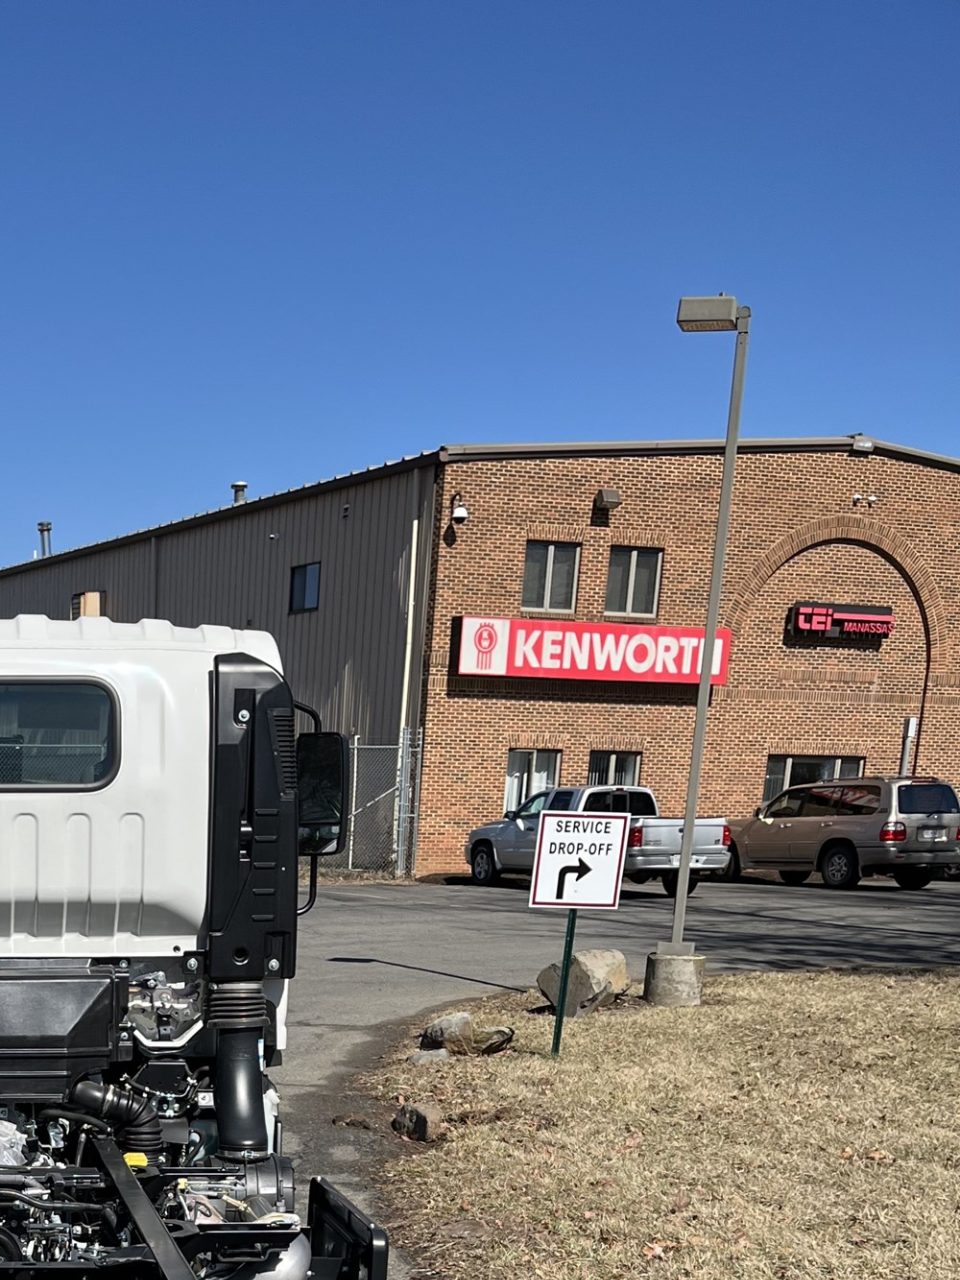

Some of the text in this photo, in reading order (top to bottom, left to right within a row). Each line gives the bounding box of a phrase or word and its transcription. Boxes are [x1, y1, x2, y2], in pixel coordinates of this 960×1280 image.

[843, 622, 896, 634] MANASSAS
[514, 628, 724, 675] KENWORTH
[556, 820, 612, 834] SERVICE
[549, 842, 613, 856] DROP-OFF
